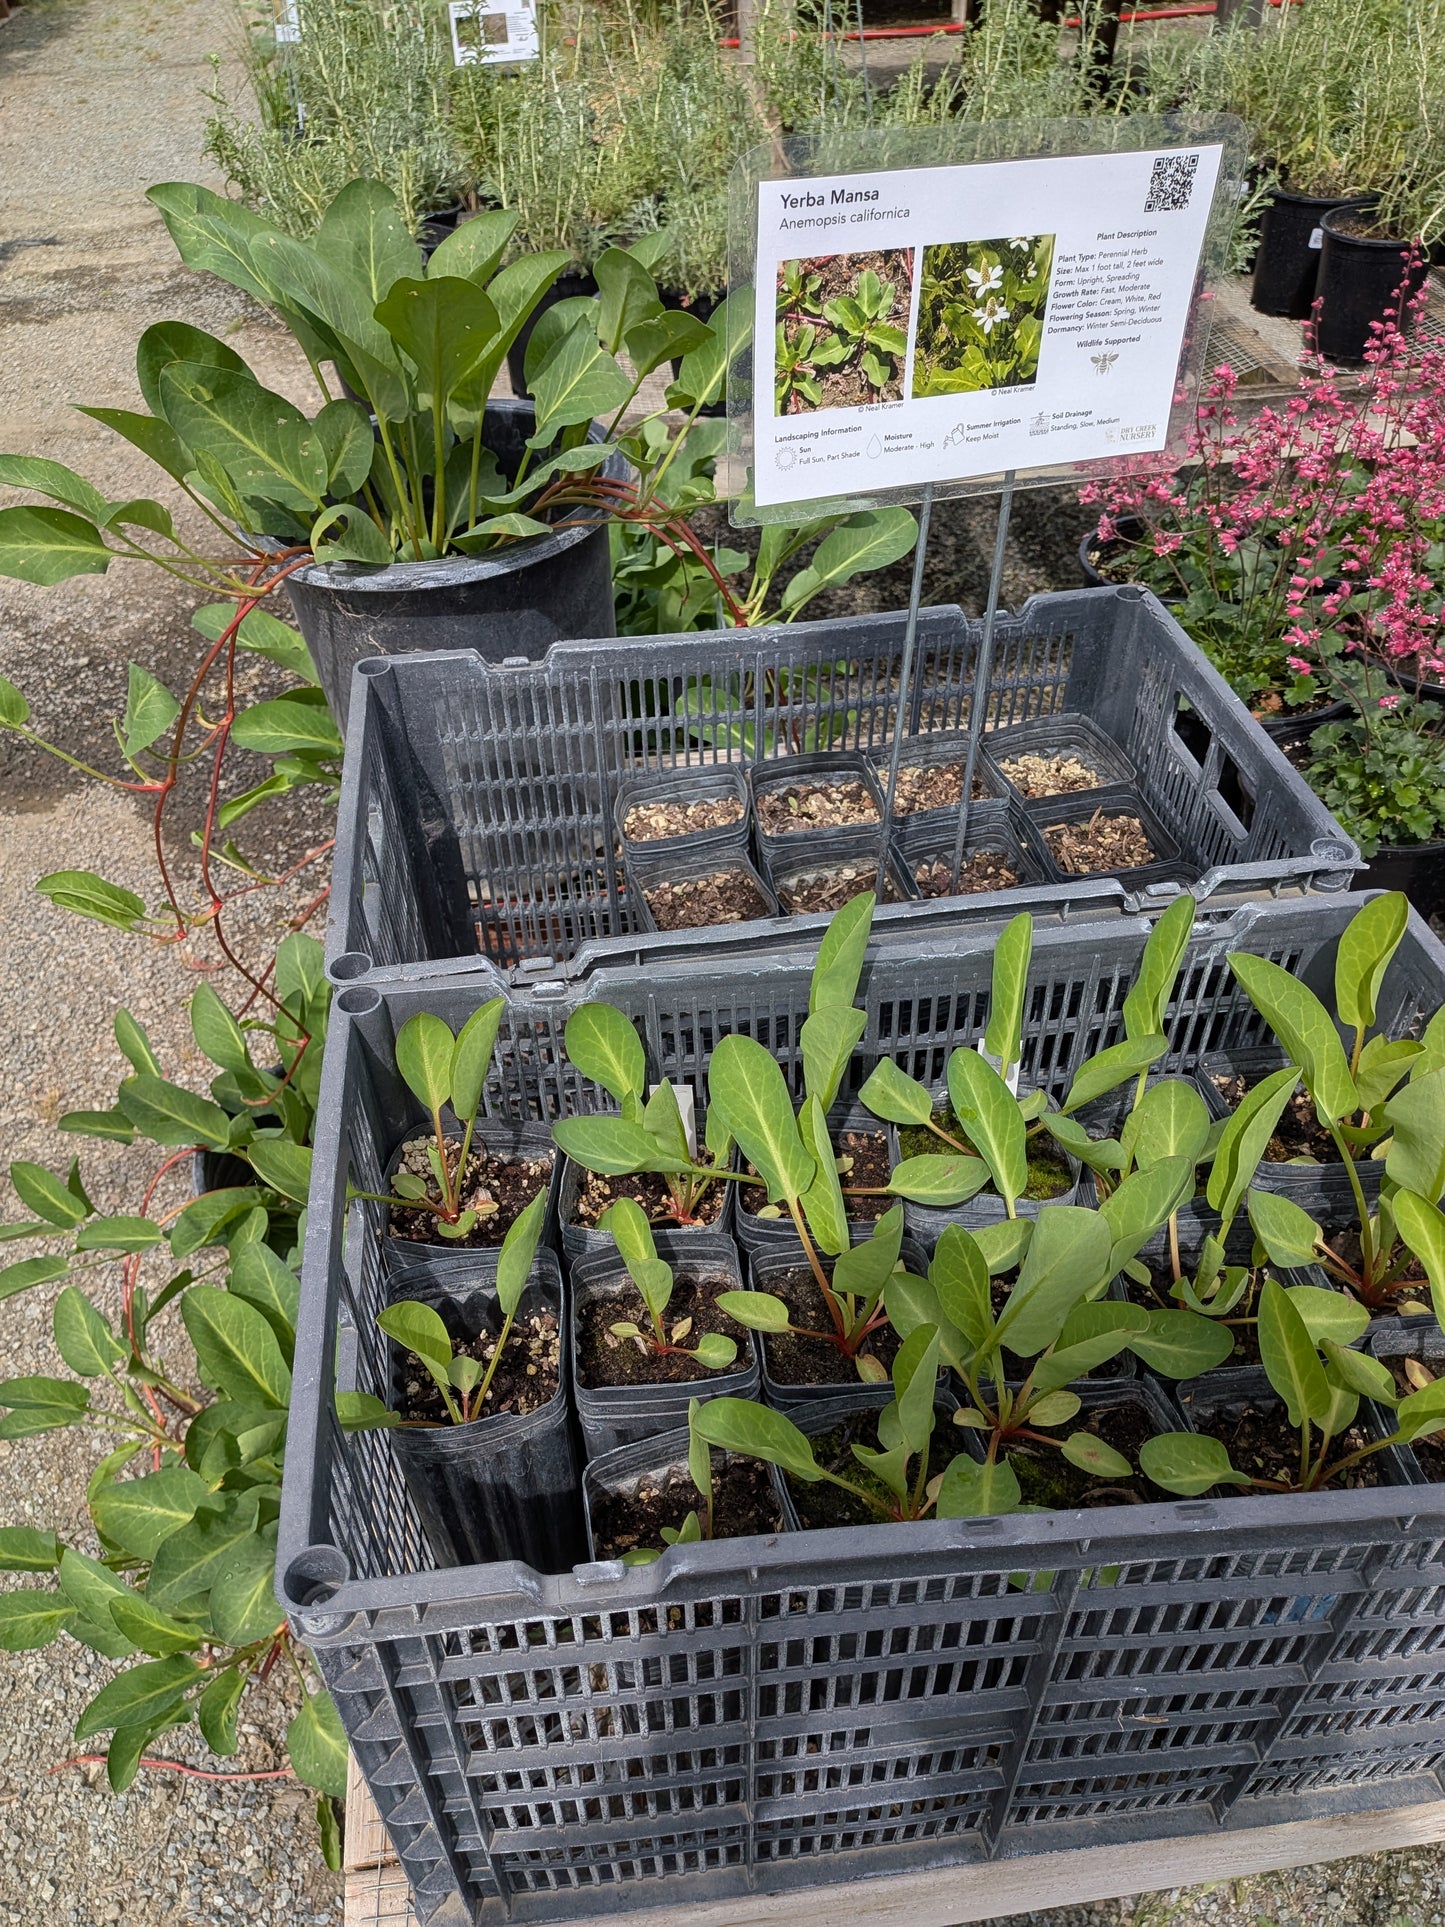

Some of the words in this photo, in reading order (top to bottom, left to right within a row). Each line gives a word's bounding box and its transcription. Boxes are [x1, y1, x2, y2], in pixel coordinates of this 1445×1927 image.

[780, 192, 824, 209] Yerba
[830, 189, 879, 204] Mansa
[780, 212, 846, 230] Anemopsis
[850, 207, 910, 222] californica
[1117, 230, 1157, 239] Description
[1078, 254, 1096, 262] Type:
[1098, 249, 1129, 258] Perennial
[1131, 248, 1148, 256] Herb
[1113, 262, 1124, 270] tall,
[1078, 276, 1104, 286] Upright,
[1106, 273, 1140, 283] Spreading
[1053, 291, 1079, 299] Growth
[1118, 284, 1150, 292] Moderate
[1051, 303, 1075, 311] Flower
[1077, 300, 1097, 308] Color:
[1100, 298, 1122, 306] Cream,
[1125, 295, 1145, 303] White,
[1049, 313, 1083, 322] Flowering
[1086, 311, 1111, 319] Season:
[1114, 308, 1136, 316] Spring,
[1048, 325, 1084, 334] Dormancy:
[1087, 322, 1108, 330] Winter
[1110, 317, 1162, 328] Semi-Deciduous
[1077, 340, 1102, 348] Wildlife
[1105, 335, 1140, 346] Supported
[1013, 385, 1035, 393] Kramer
[865, 404, 880, 412] Neal
[881, 402, 904, 410] Kramer
[1065, 410, 1092, 418] Drainage
[966, 422, 992, 430] Summer
[994, 418, 1021, 427] Irrigation
[1051, 423, 1078, 432] Standing,
[775, 431, 819, 443] Landscaping
[821, 426, 862, 436] Information
[884, 432, 912, 441] Moisture
[966, 434, 981, 443] Keep
[1120, 431, 1156, 441] NURSERY
[884, 444, 914, 453] Moderate
[920, 442, 934, 450] High
[812, 456, 825, 464] Sun,
[841, 451, 860, 460] Shade
